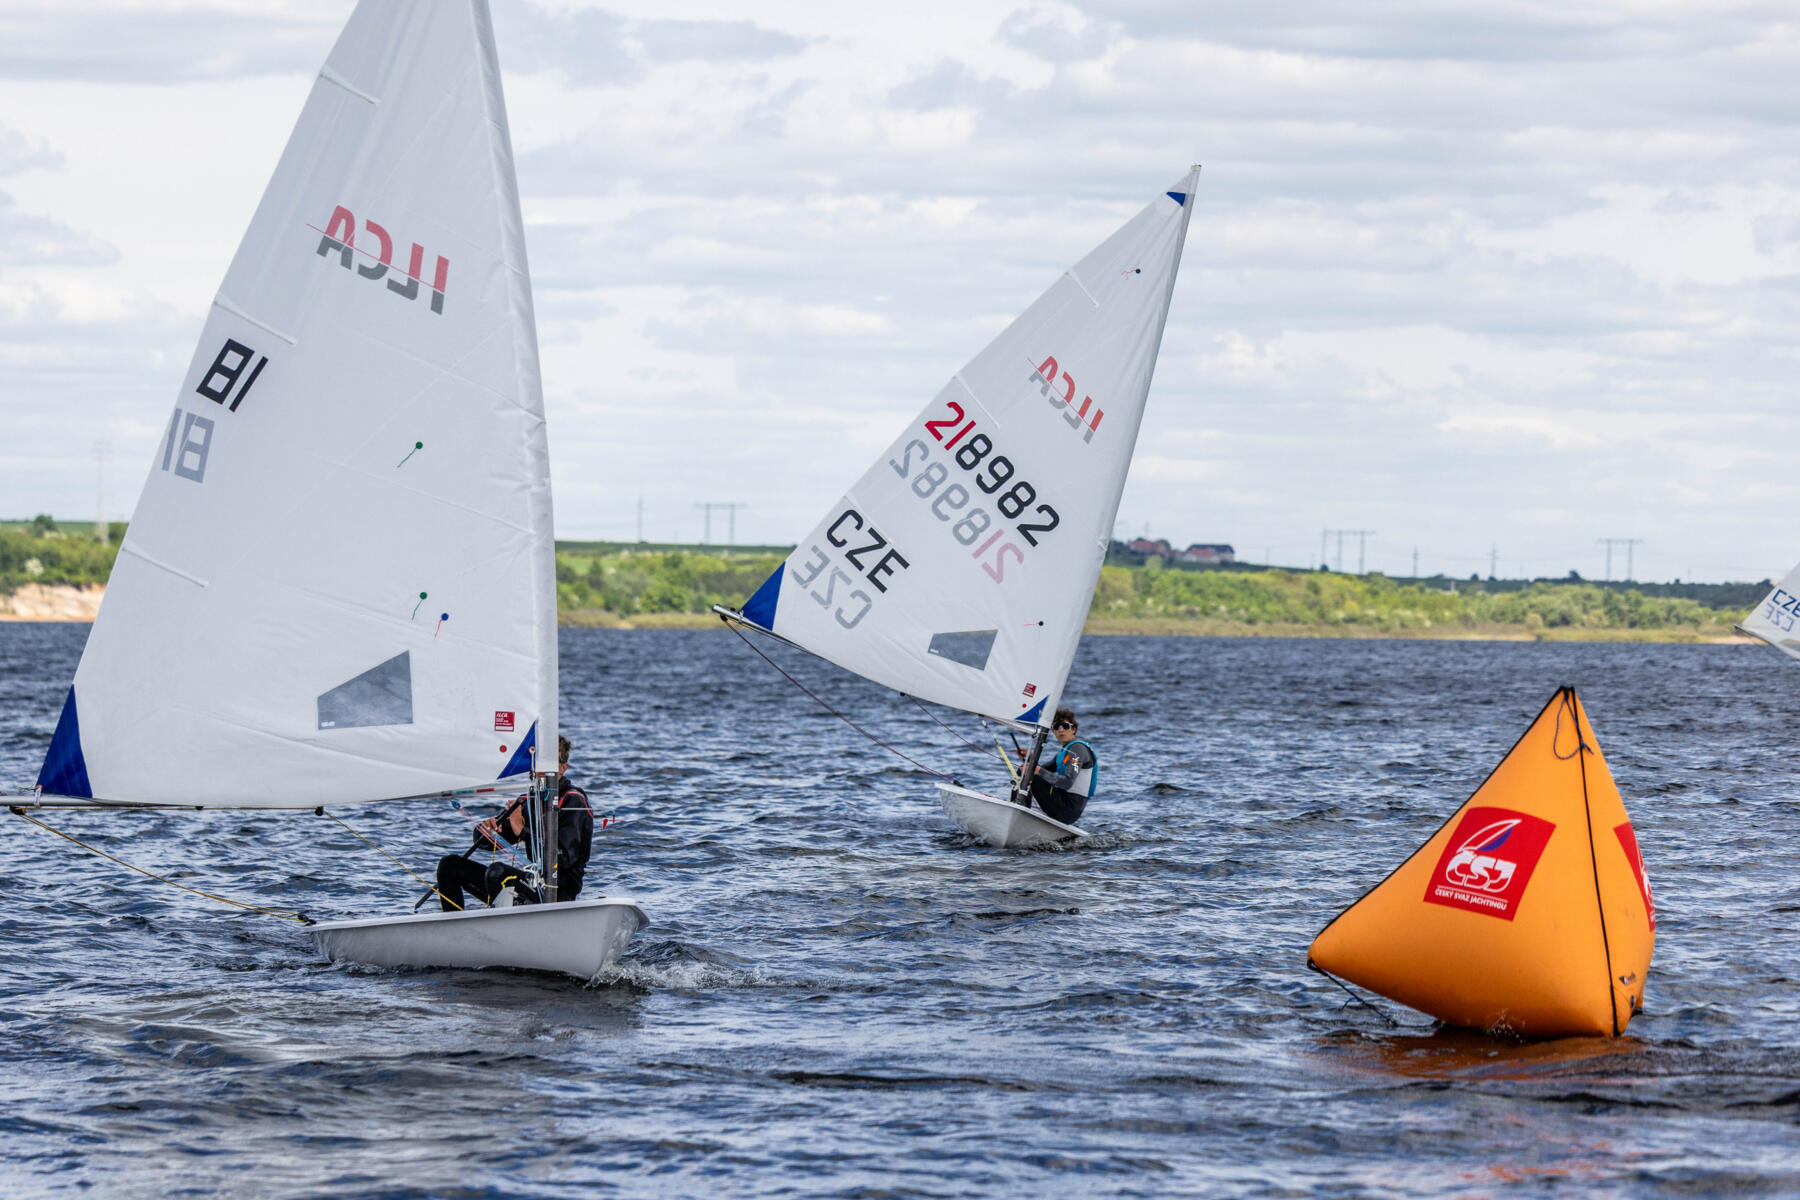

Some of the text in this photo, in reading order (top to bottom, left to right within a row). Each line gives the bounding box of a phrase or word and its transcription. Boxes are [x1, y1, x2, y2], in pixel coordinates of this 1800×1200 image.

[195, 338, 269, 413] 81
[924, 401, 1060, 547] 218982
[826, 509, 910, 594] CZE
[1454, 892, 1470, 902] SVAZ
[1470, 895, 1508, 911] JACHTINGU
